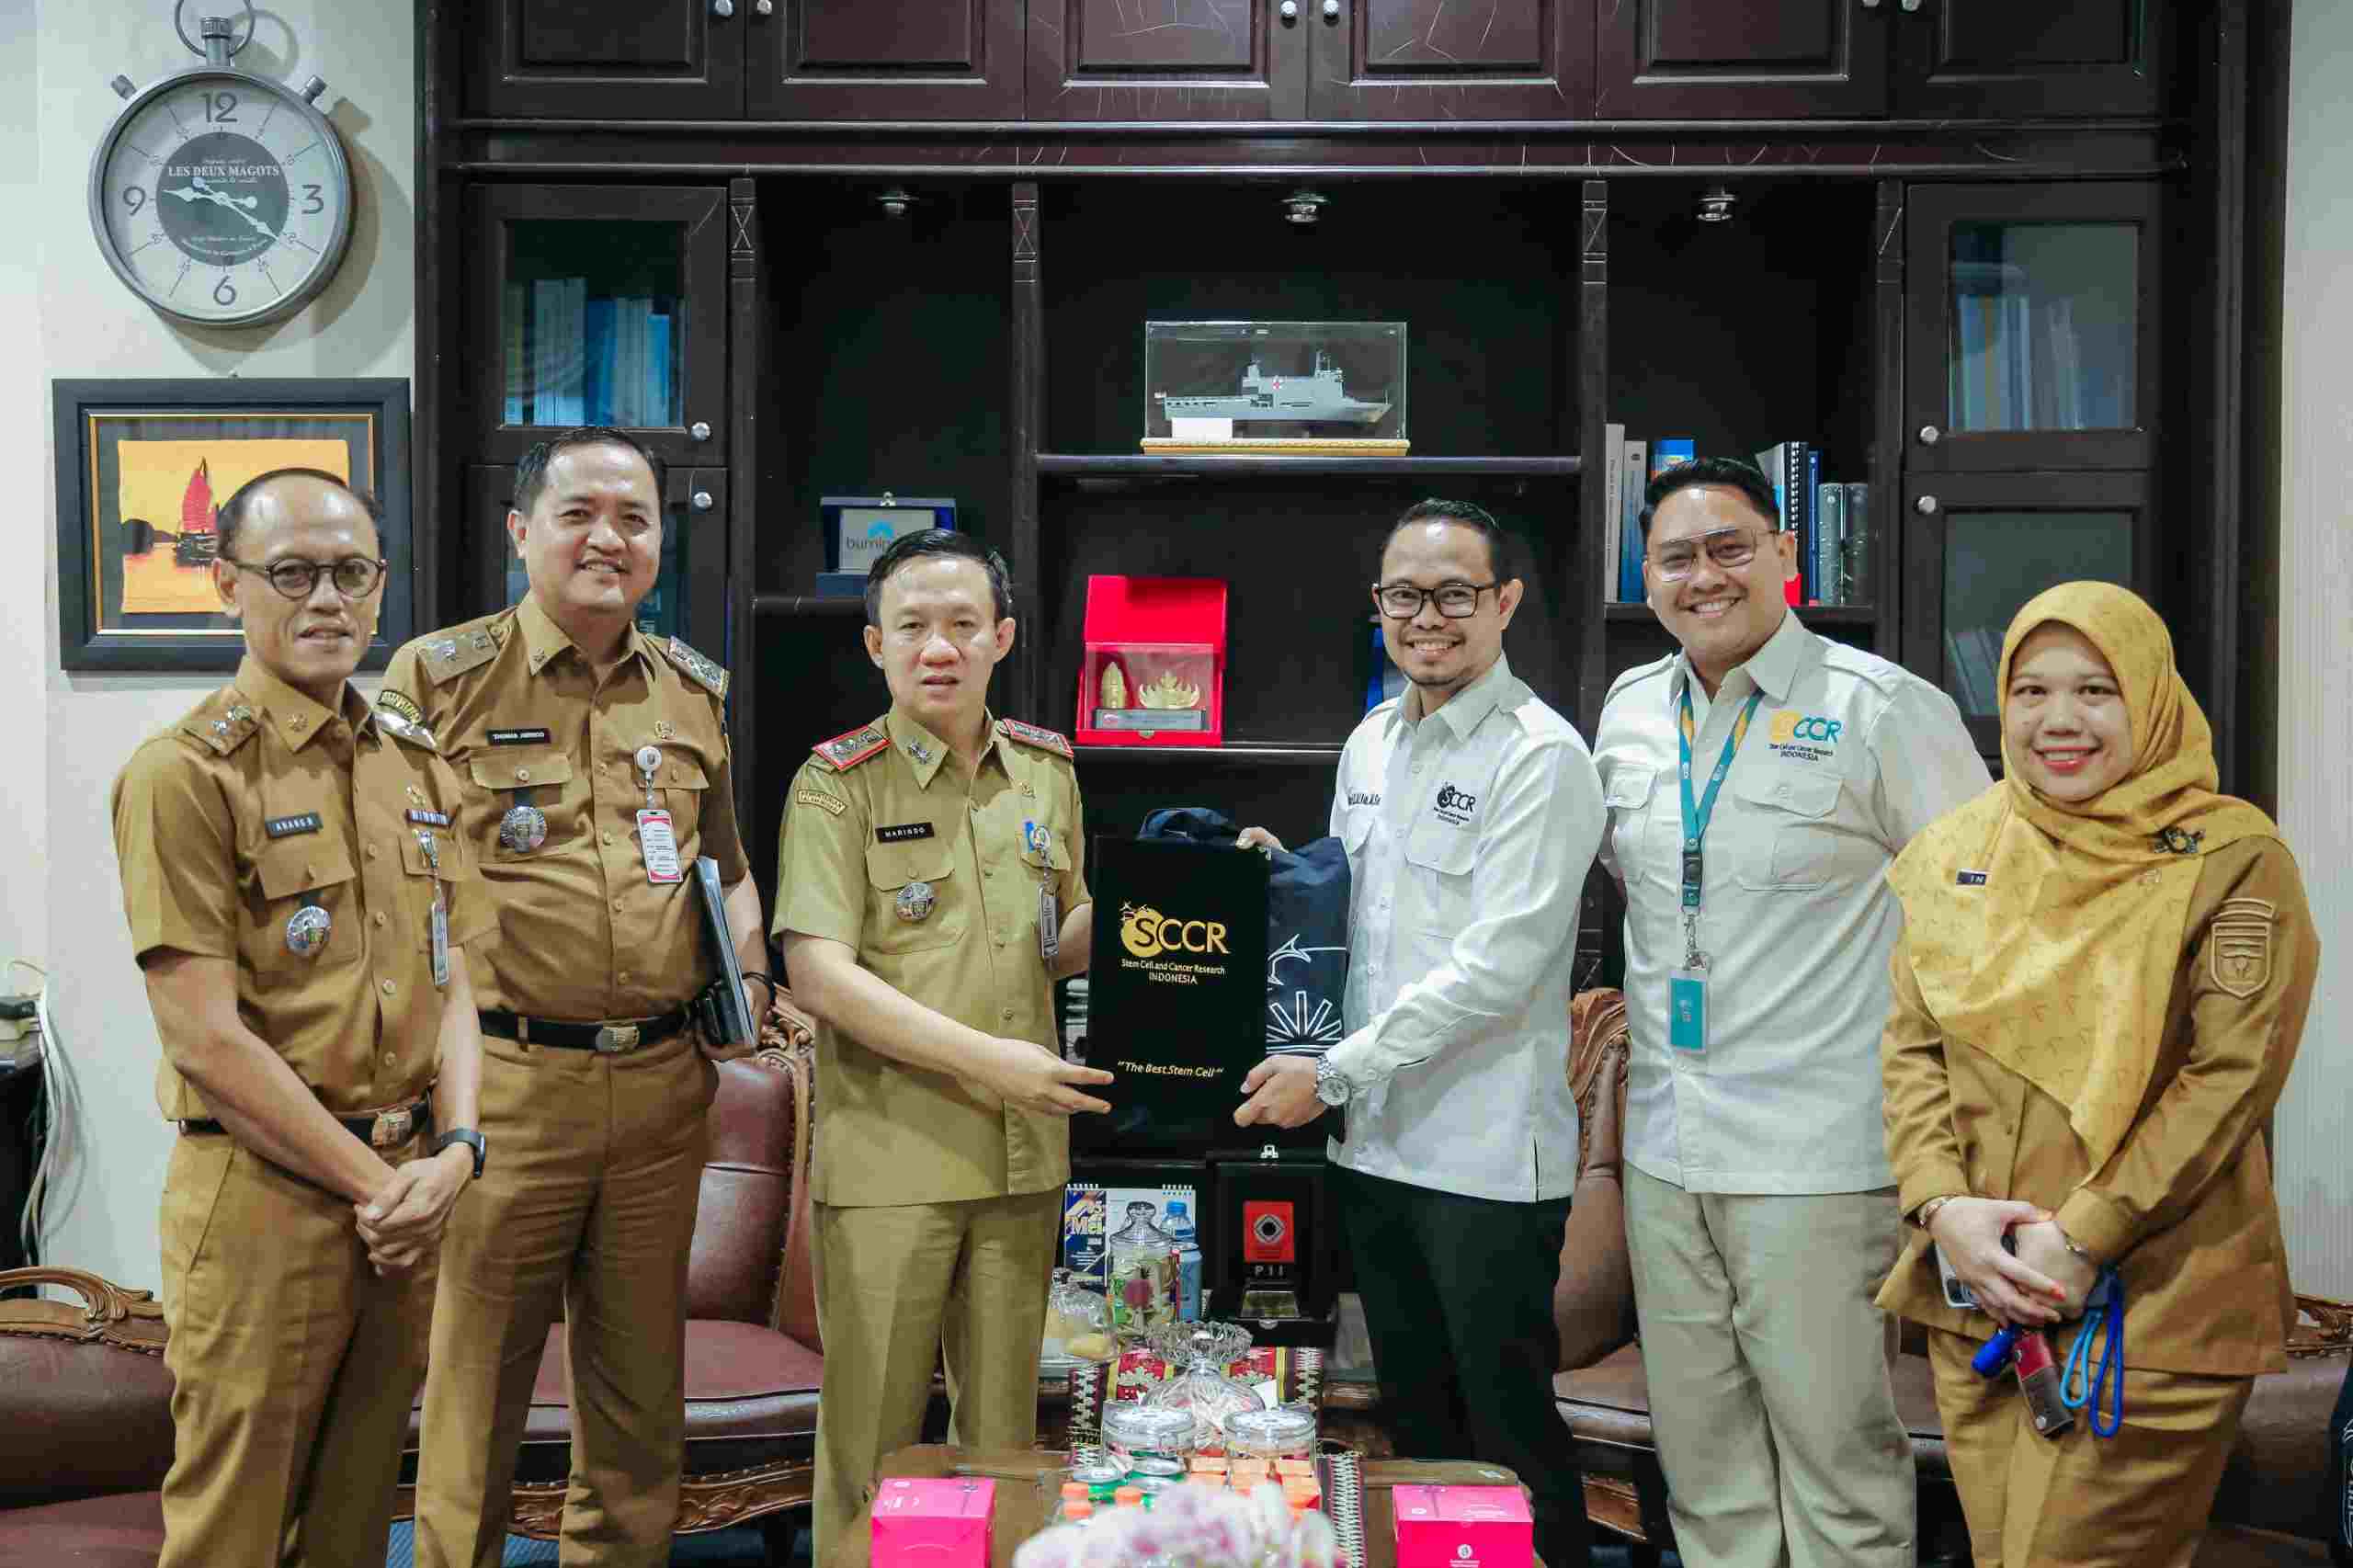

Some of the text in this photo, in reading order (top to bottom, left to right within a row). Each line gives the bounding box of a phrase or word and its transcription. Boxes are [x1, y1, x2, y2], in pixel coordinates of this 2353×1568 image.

[199, 92, 238, 122] 12
[168, 165, 280, 177] LES DEUX MAGOTS
[122, 186, 147, 216] 9
[301, 184, 324, 214] 3
[212, 275, 237, 306] 6
[1133, 917, 1232, 955] SCCR
[1120, 958, 1140, 969] Stem
[1168, 962, 1193, 973] Cancer
[1193, 964, 1226, 976] Research
[1148, 971, 1199, 985] INDONESIA
[1145, 1062, 1167, 1074] Best
[1168, 1064, 1193, 1076] Stem
